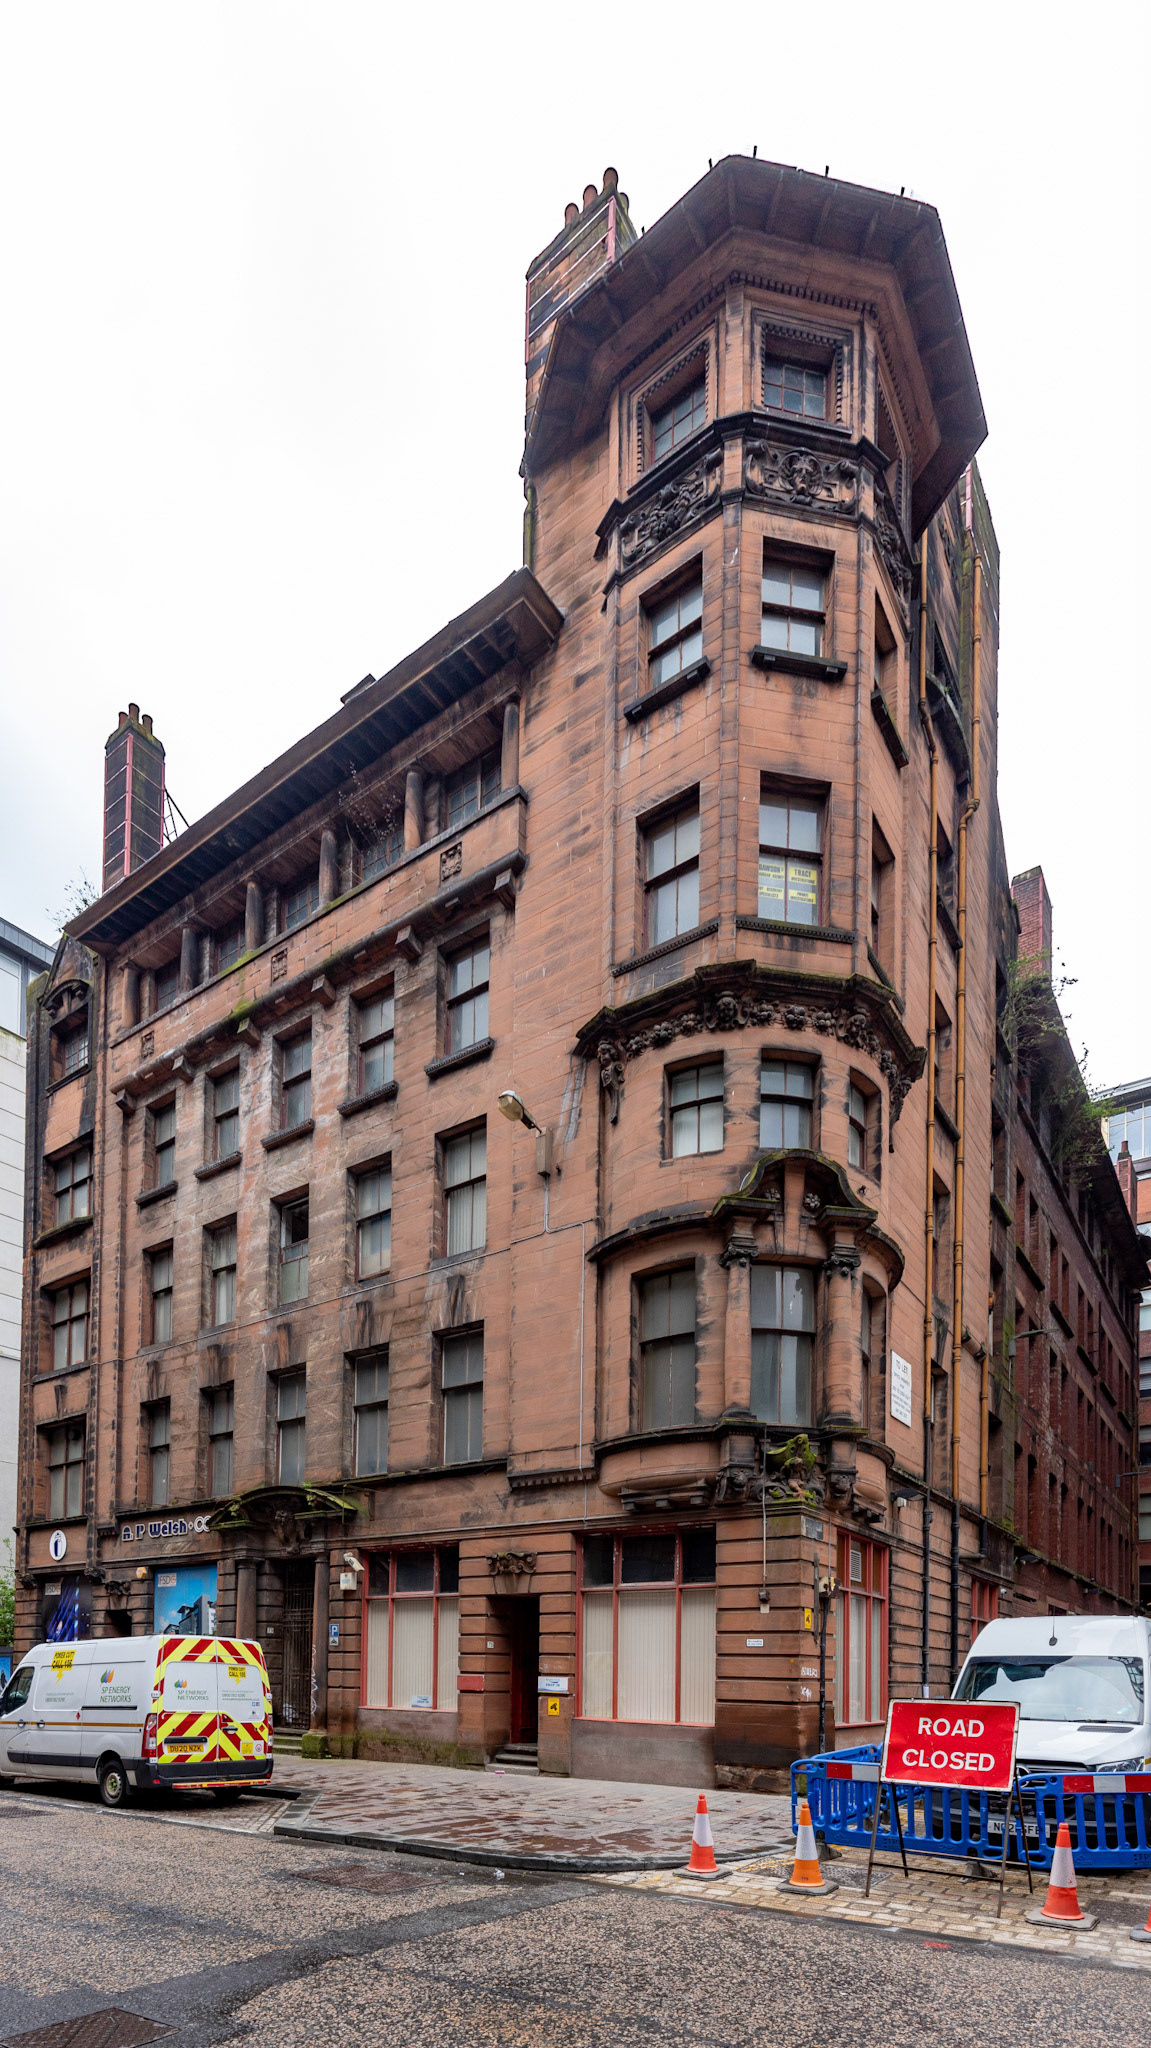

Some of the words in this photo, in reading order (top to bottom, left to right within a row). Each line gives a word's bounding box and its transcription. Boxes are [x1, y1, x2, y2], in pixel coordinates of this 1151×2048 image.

[148, 1519, 188, 1538] Welsh
[51, 1660, 63, 1669] CALL
[101, 1686, 109, 1694] SP
[109, 1686, 131, 1694] ENERGY
[100, 1695, 132, 1703] NETWORKS
[917, 1717, 985, 1738] ROAD
[902, 1748, 995, 1772] CLOSED
